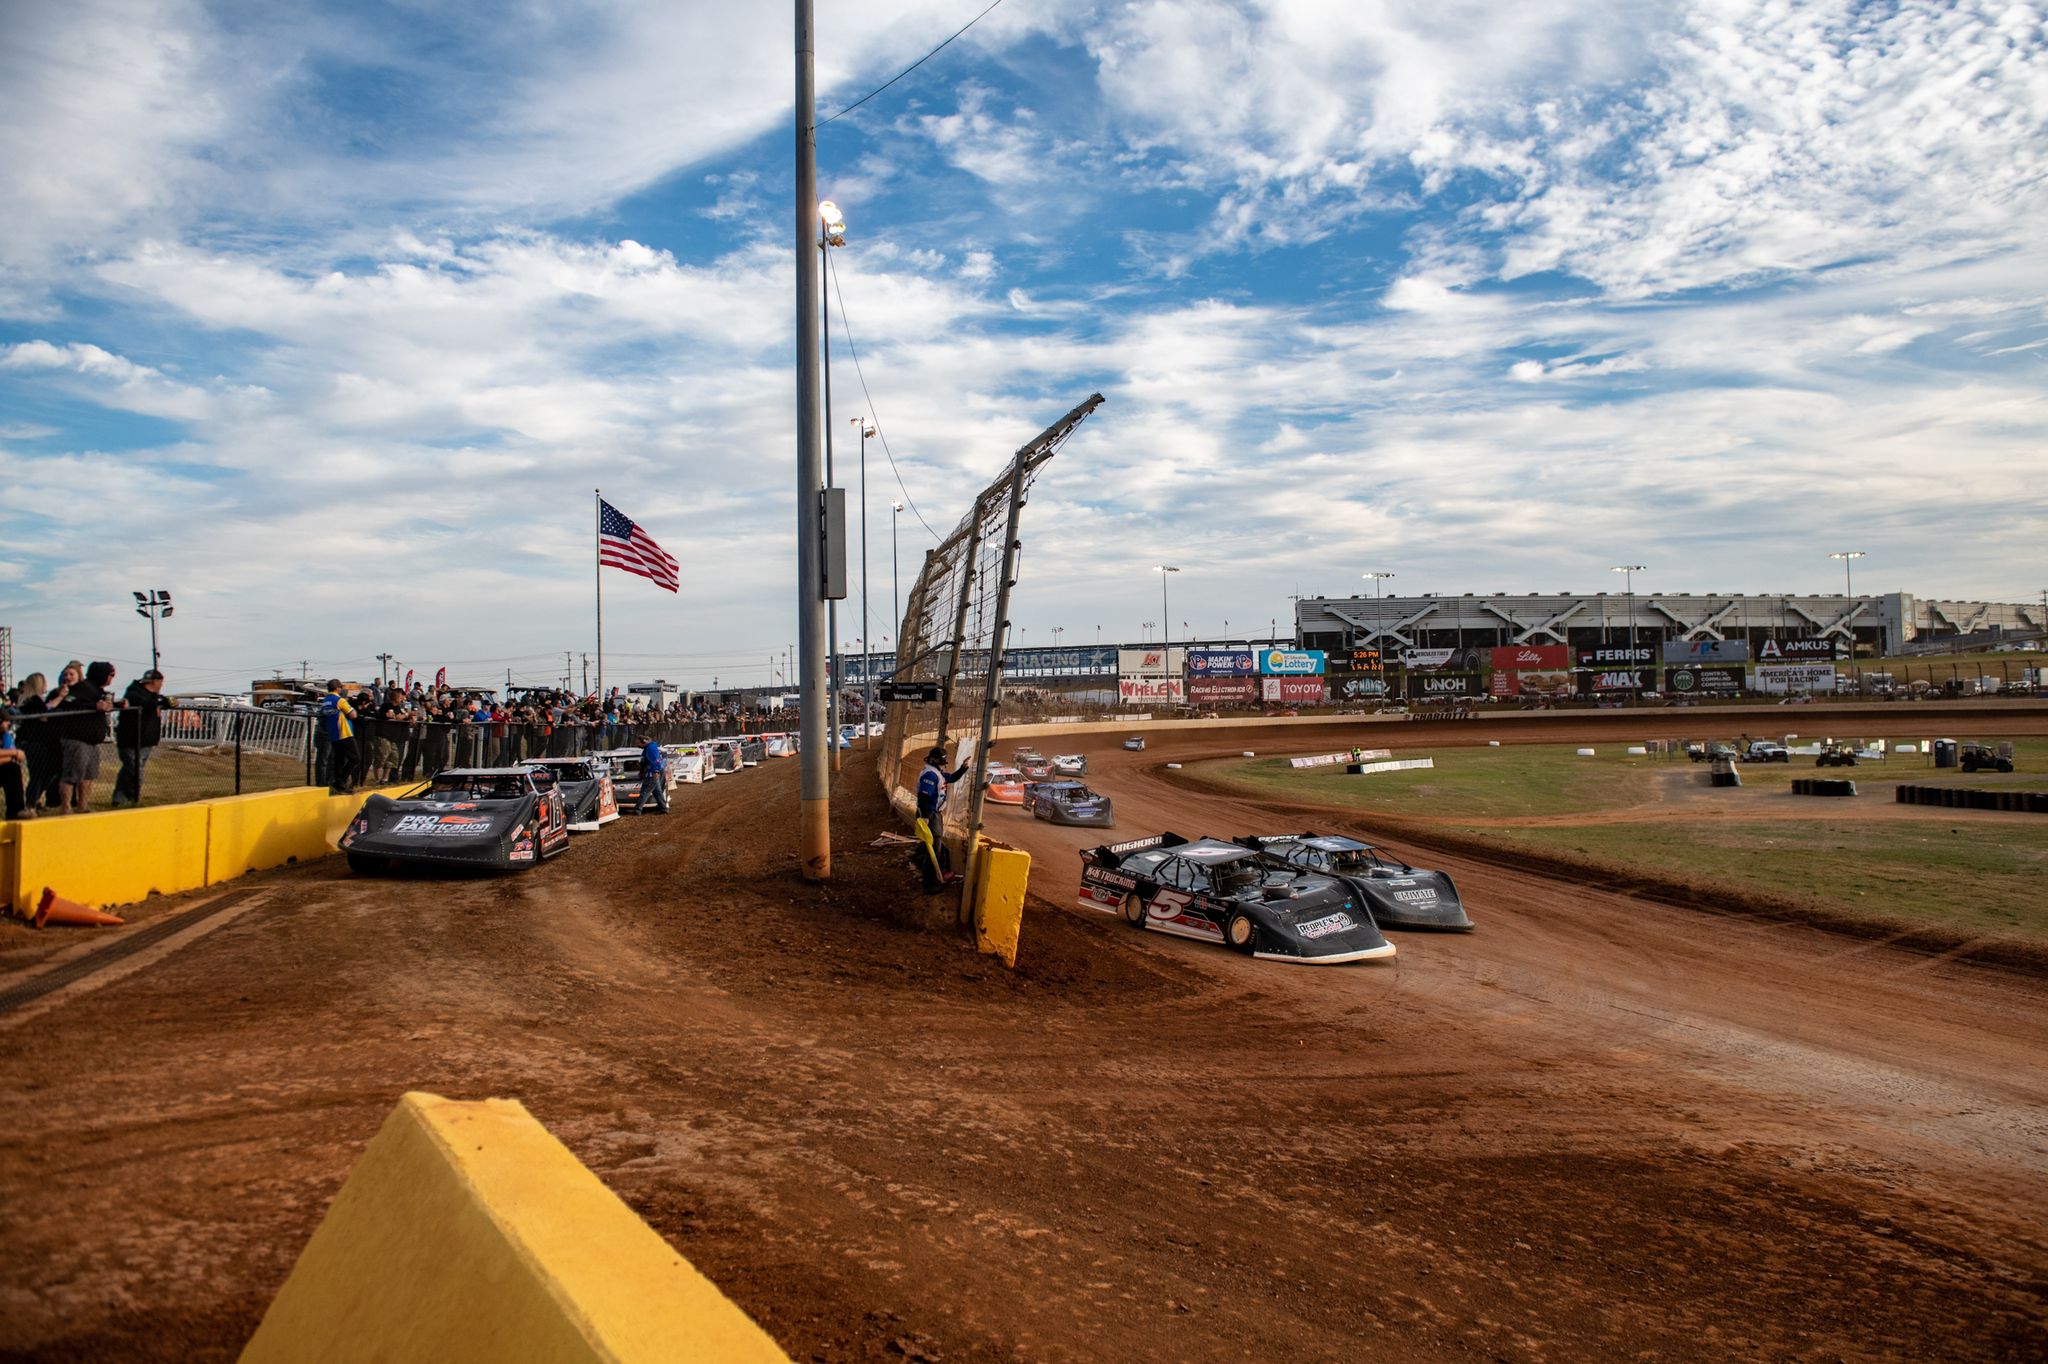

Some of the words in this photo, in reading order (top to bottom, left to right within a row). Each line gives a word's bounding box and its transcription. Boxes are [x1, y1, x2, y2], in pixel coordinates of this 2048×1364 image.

[1785, 640, 1831, 650] AMKUS
[1516, 649, 1542, 664] Lilly
[1596, 648, 1650, 660] FERRIS
[1017, 654, 1080, 667] RACING
[1284, 660, 1314, 669] Lottery
[1119, 680, 1180, 696] WHELEN
[1283, 684, 1322, 694] TOYOTA
[1424, 678, 1466, 690] UNOH
[1413, 712, 1470, 720] CHARLOTTE
[391, 822, 491, 833] FABrication
[1101, 870, 1137, 889] TRUCKING
[1394, 888, 1437, 902] ULTIMATE
[1148, 886, 1194, 920] 5
